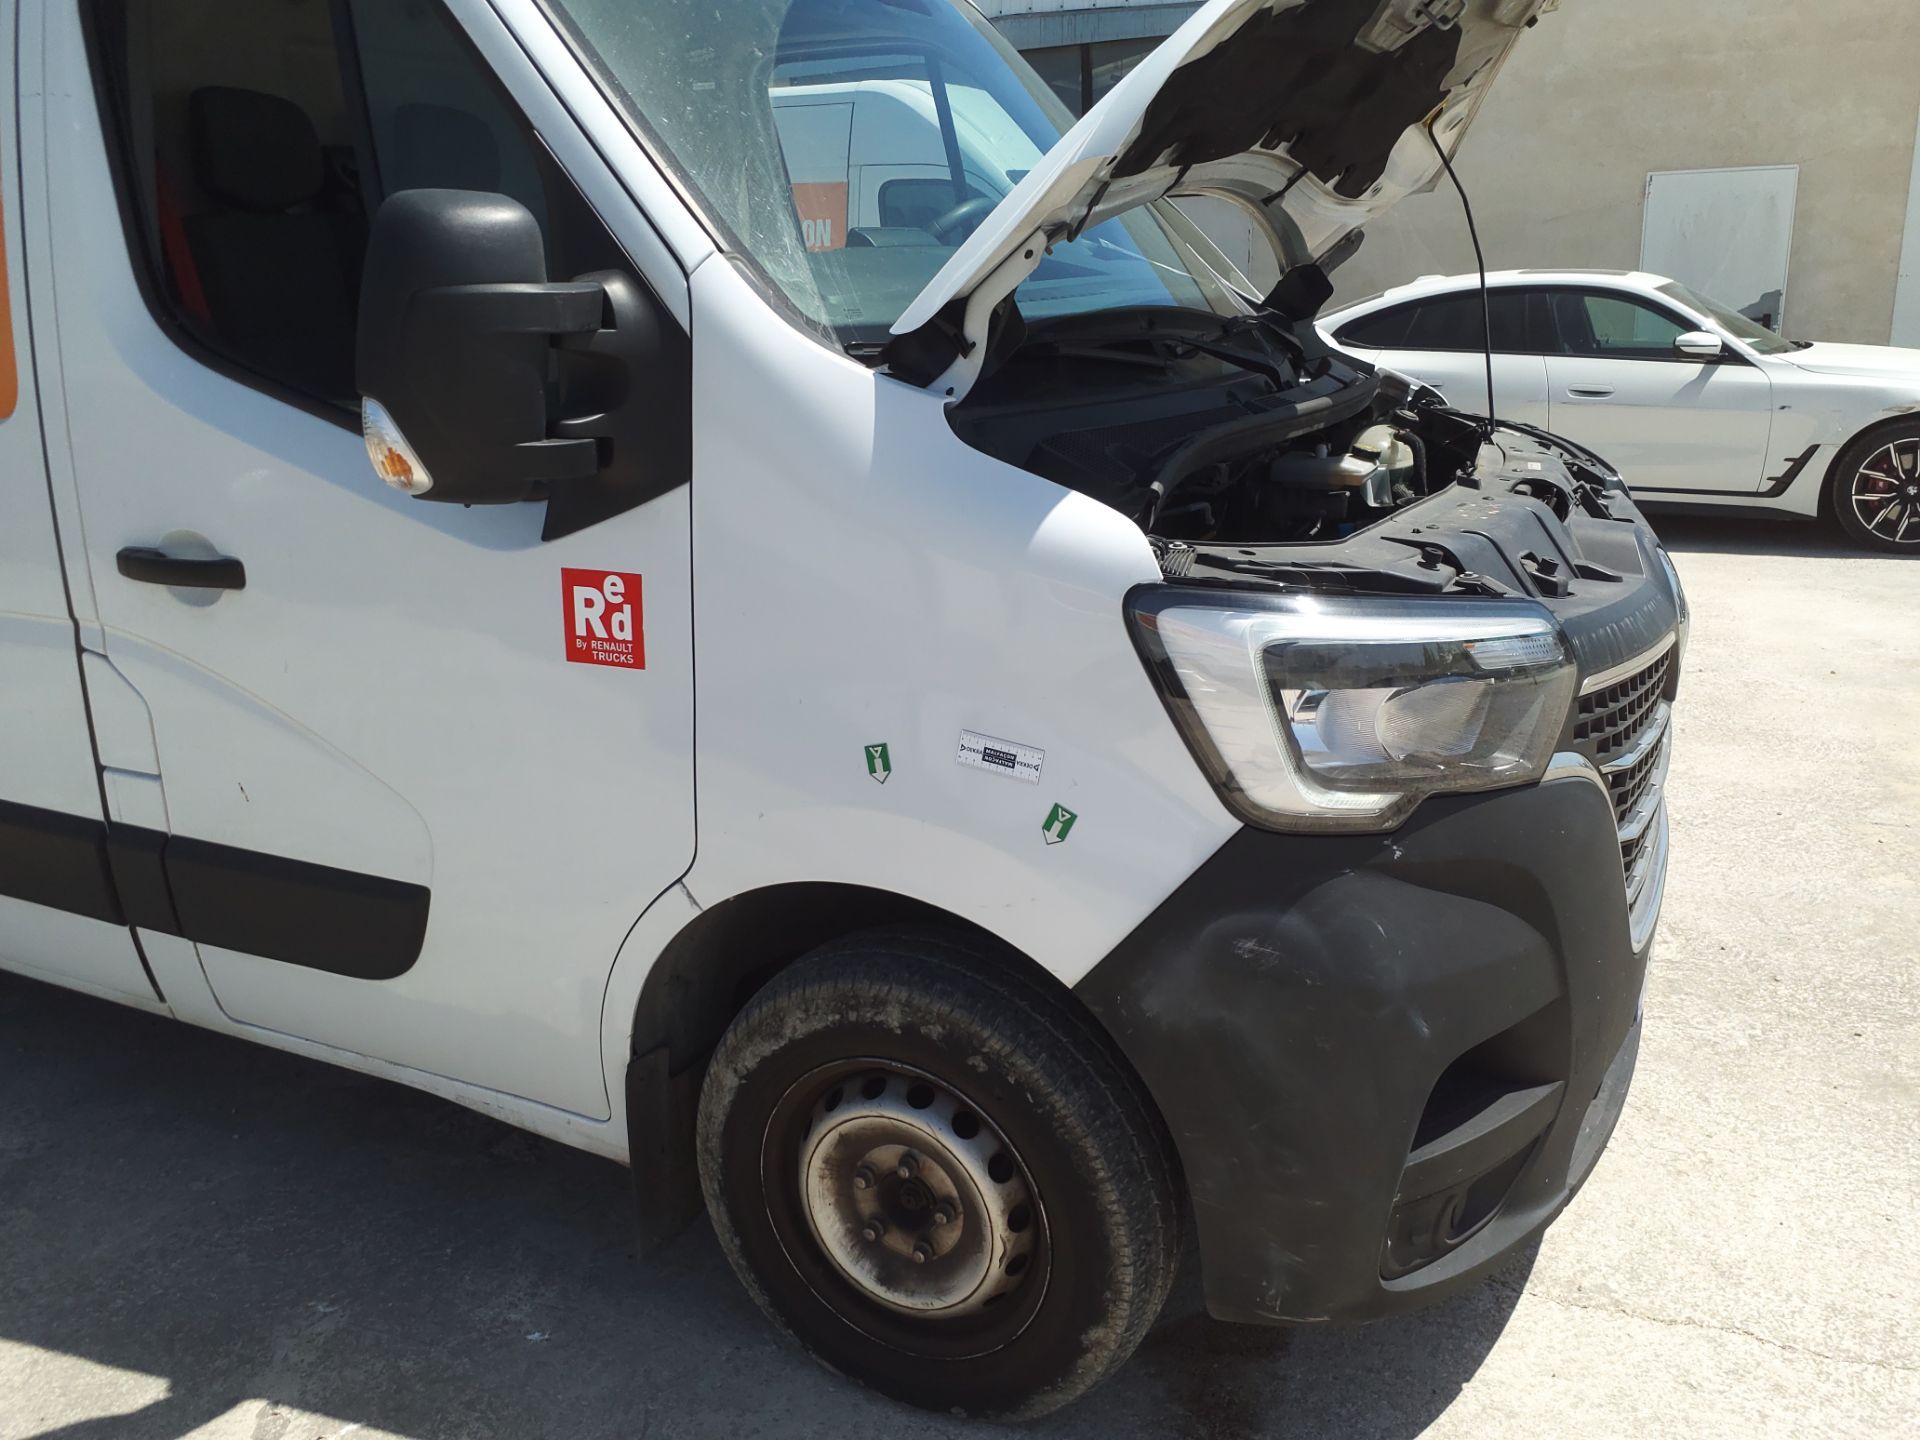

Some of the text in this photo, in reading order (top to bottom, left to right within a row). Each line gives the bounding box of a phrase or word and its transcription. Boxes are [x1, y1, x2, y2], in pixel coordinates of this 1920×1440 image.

[576, 639, 633, 653] By RENAULT
[592, 651, 634, 664] TRUCKS
